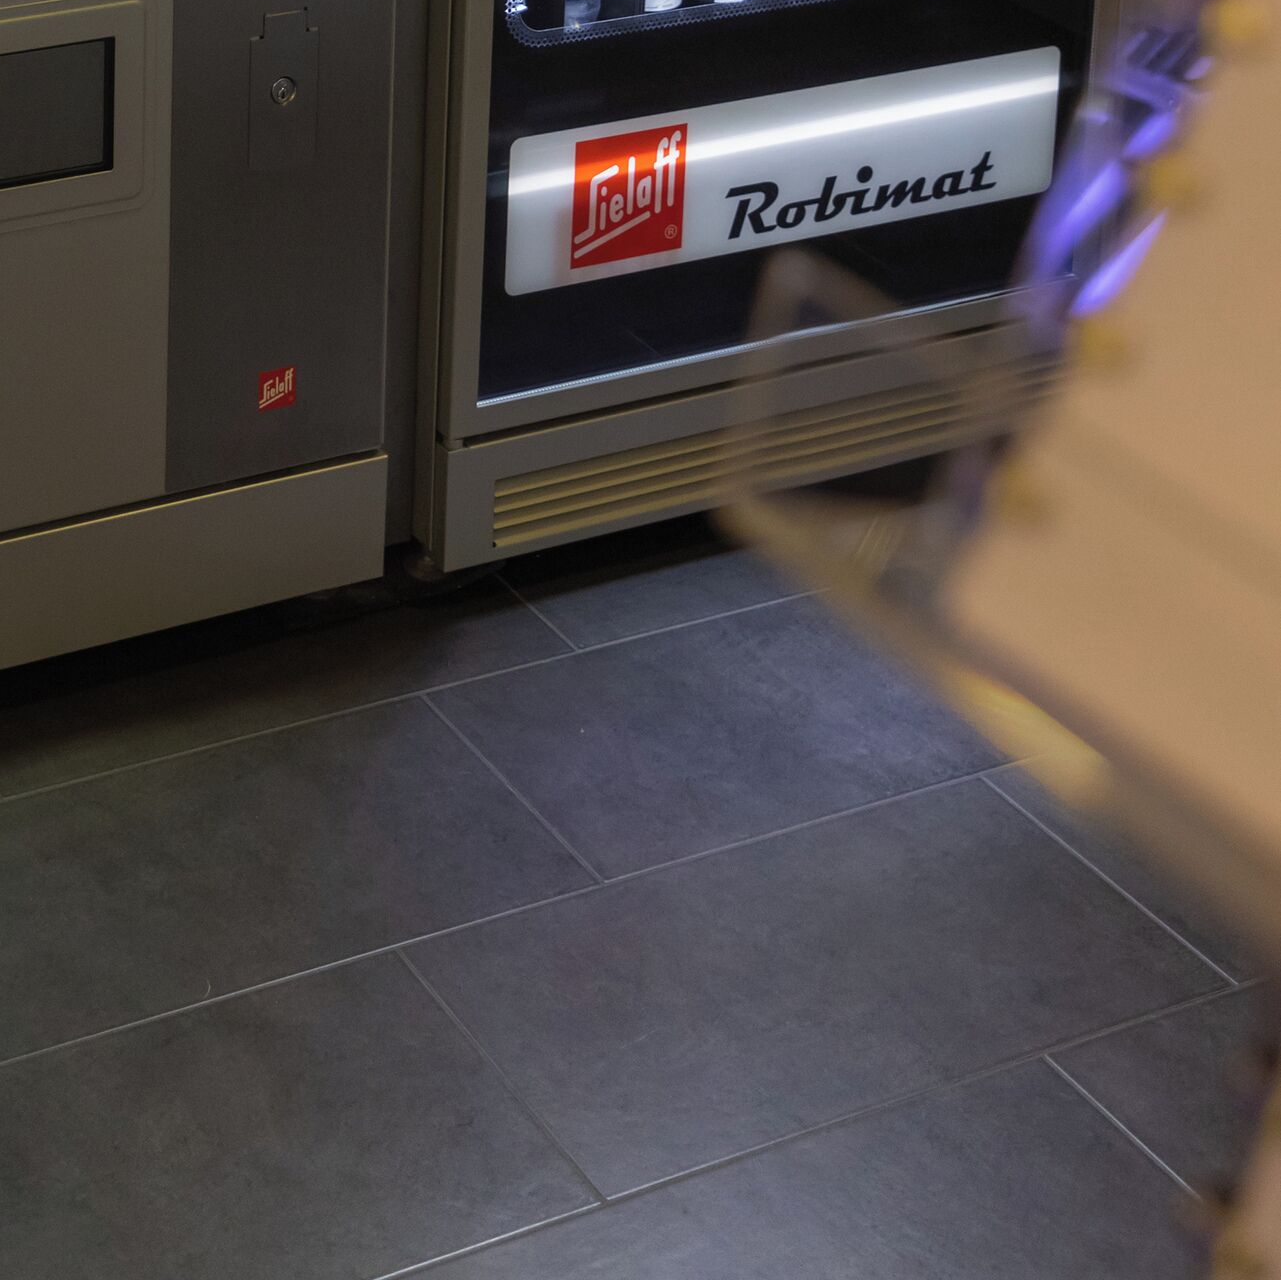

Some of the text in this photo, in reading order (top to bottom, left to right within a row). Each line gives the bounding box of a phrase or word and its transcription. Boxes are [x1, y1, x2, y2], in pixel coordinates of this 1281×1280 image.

[574, 129, 682, 244] Sielaff
[724, 150, 997, 240] Robimat
[259, 369, 293, 408] Sielaff
